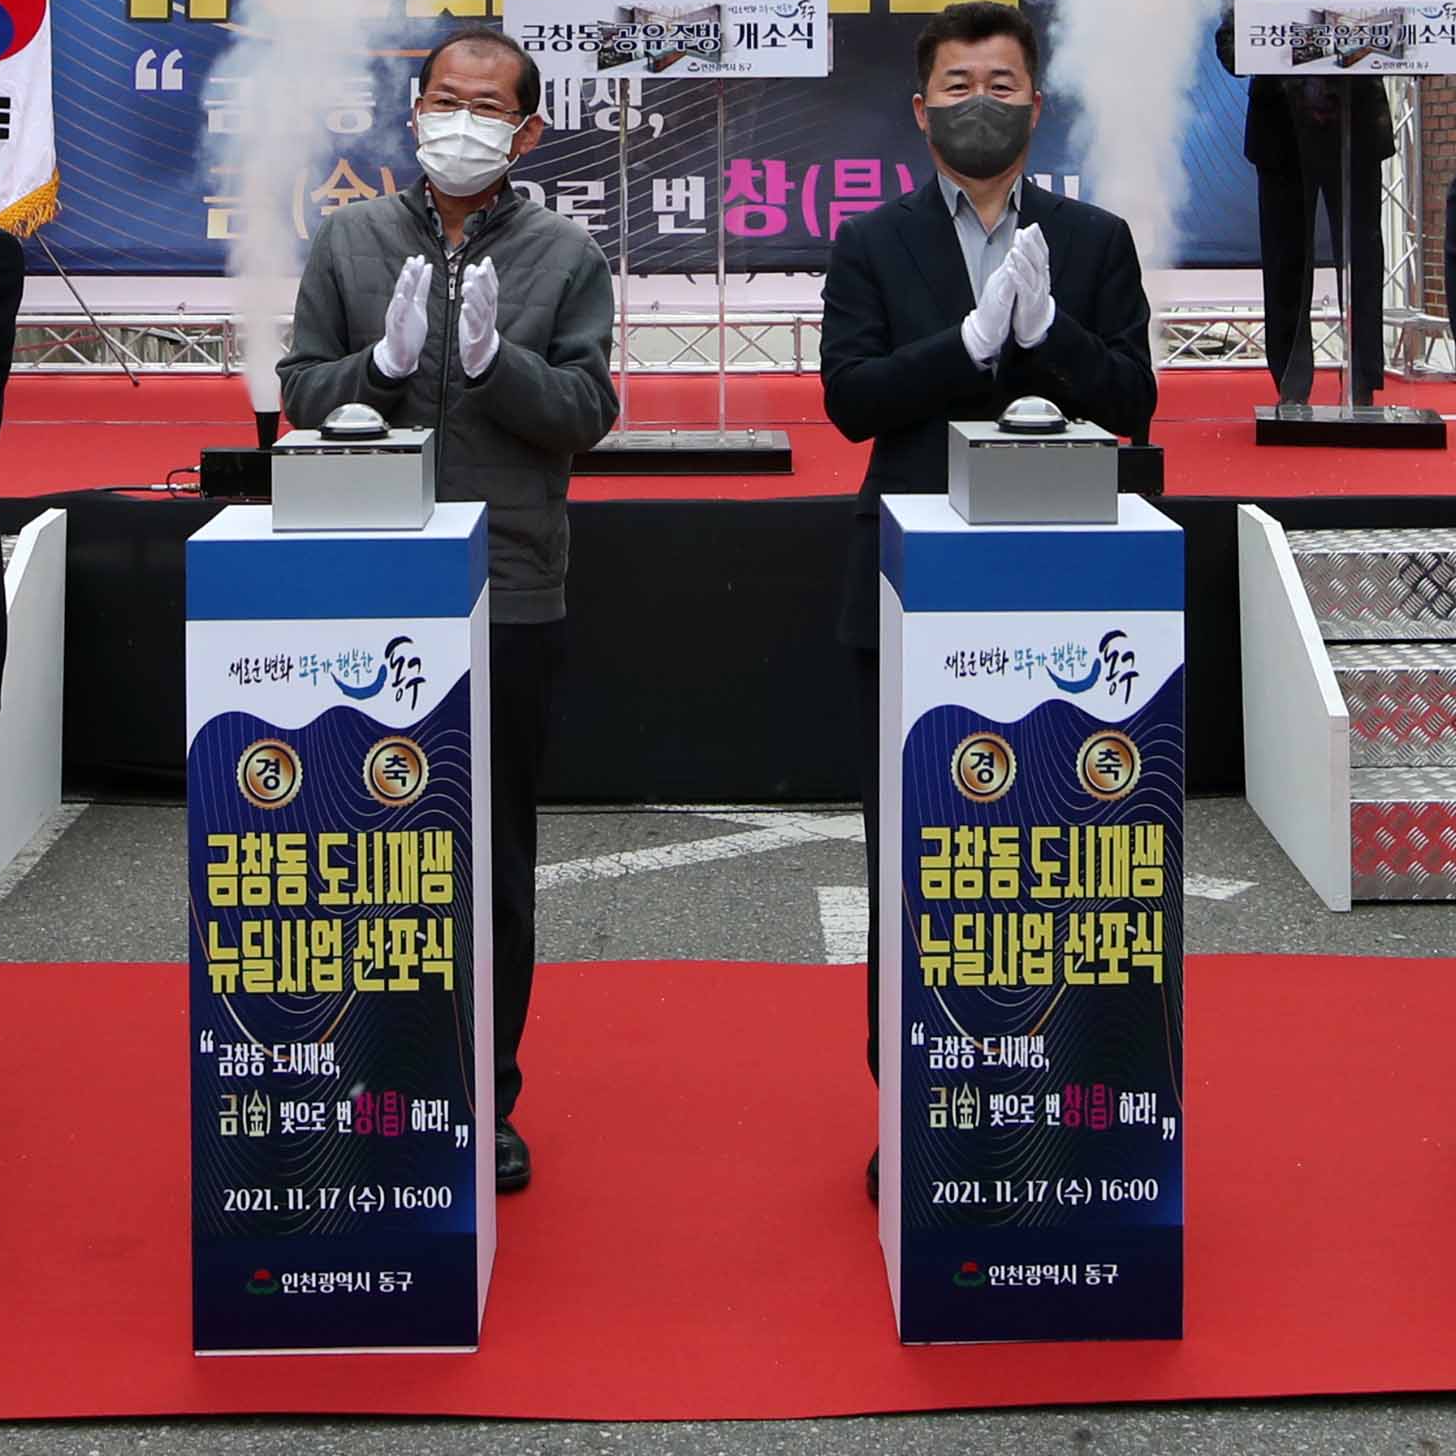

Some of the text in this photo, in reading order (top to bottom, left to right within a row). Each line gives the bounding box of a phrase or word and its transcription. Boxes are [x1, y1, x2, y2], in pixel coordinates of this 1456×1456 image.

[520, 21, 815, 54] 금창동 공유주방 개소식
[1249, 24, 1306, 48] 금창동
[1397, 23, 1456, 46] 개소식
[256, 758, 281, 791] 경
[382, 754, 410, 787] 축
[970, 752, 994, 784] 경
[1096, 748, 1122, 781] 축
[206, 830, 453, 906] 금창동 도시재생
[920, 824, 1164, 899] 금창동 도시재생
[208, 917, 454, 994] 뉴딜사업 선포식
[920, 911, 1163, 986] 뉴딜사업 선포식
[280, 1101, 326, 1134] 빛으로
[990, 1094, 1035, 1127] 빛으로
[223, 1185, 452, 1213] 2021. 11. 17 (수) 16:00
[932, 1178, 1158, 1206] 2021. 11. 17 (수) 16:00
[281, 1272, 413, 1294] 인천광역시 동구
[988, 1264, 1118, 1286] 인천광역시 동구
